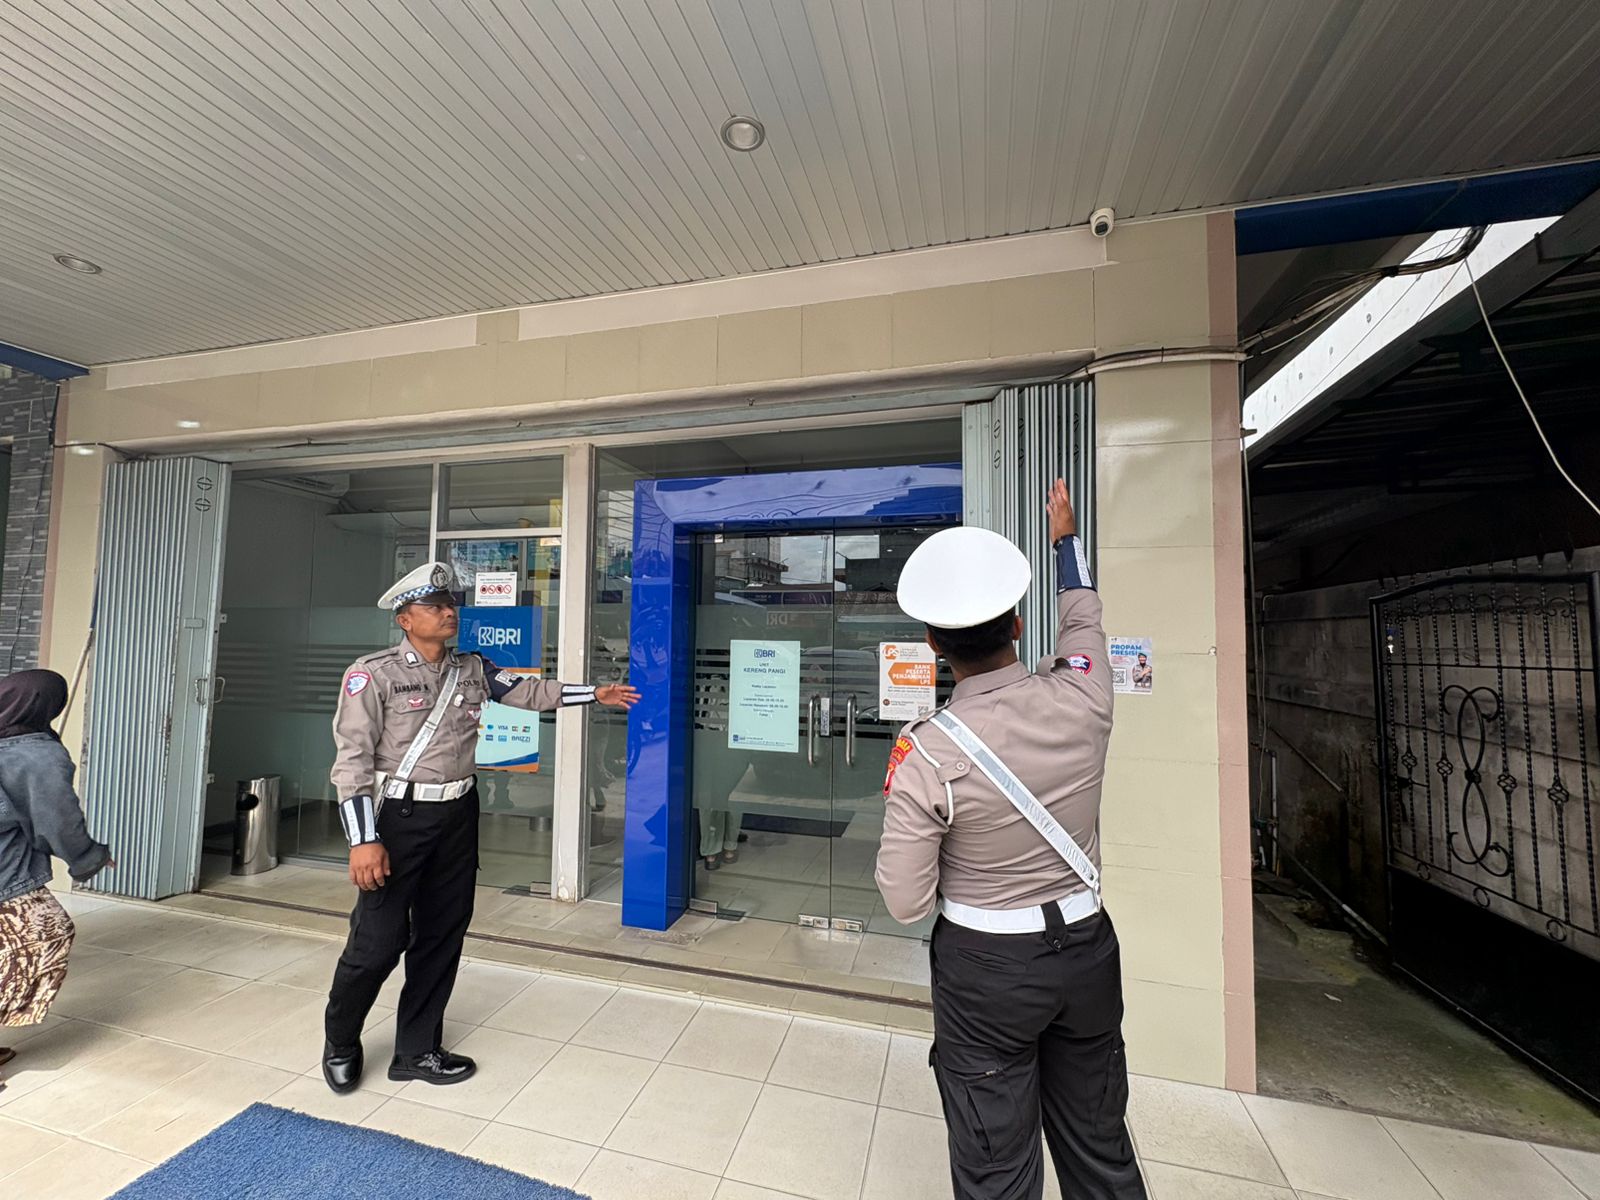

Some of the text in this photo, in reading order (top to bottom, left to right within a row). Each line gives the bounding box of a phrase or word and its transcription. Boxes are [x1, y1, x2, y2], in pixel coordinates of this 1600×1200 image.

[494, 627, 521, 645] BRI
[762, 649, 775, 658] BRI
[511, 735, 531, 743] BRIZZI
